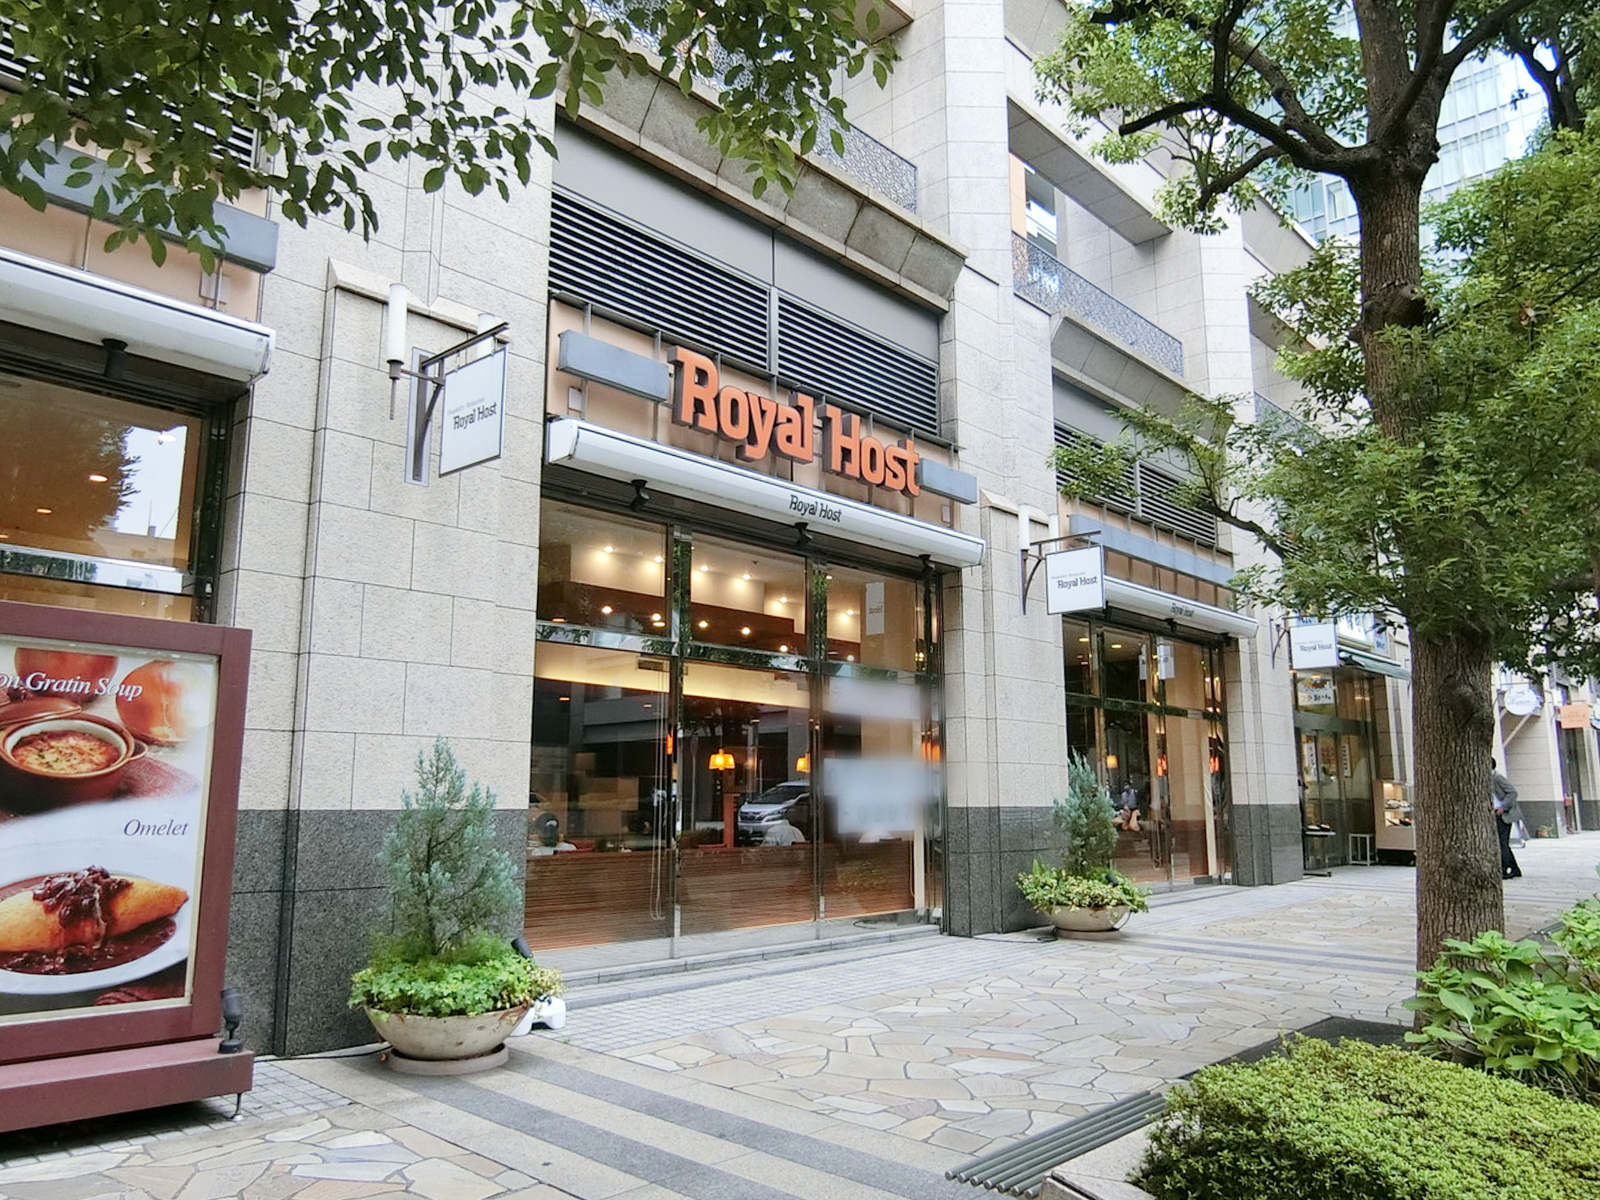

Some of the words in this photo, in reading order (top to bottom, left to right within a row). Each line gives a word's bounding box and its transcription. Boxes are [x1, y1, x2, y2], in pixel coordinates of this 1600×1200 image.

[453, 409, 475, 430] Royal
[477, 402, 497, 421] Host
[671, 346, 814, 464] Royal
[819, 404, 921, 497] Host
[789, 494, 818, 516] Royal
[819, 502, 842, 522] Host
[1057, 577, 1078, 589] Royal
[1079, 576, 1098, 585] Host
[25, 672, 91, 695] Gratin
[95, 677, 143, 702] Soup
[123, 819, 189, 836] Omelet
